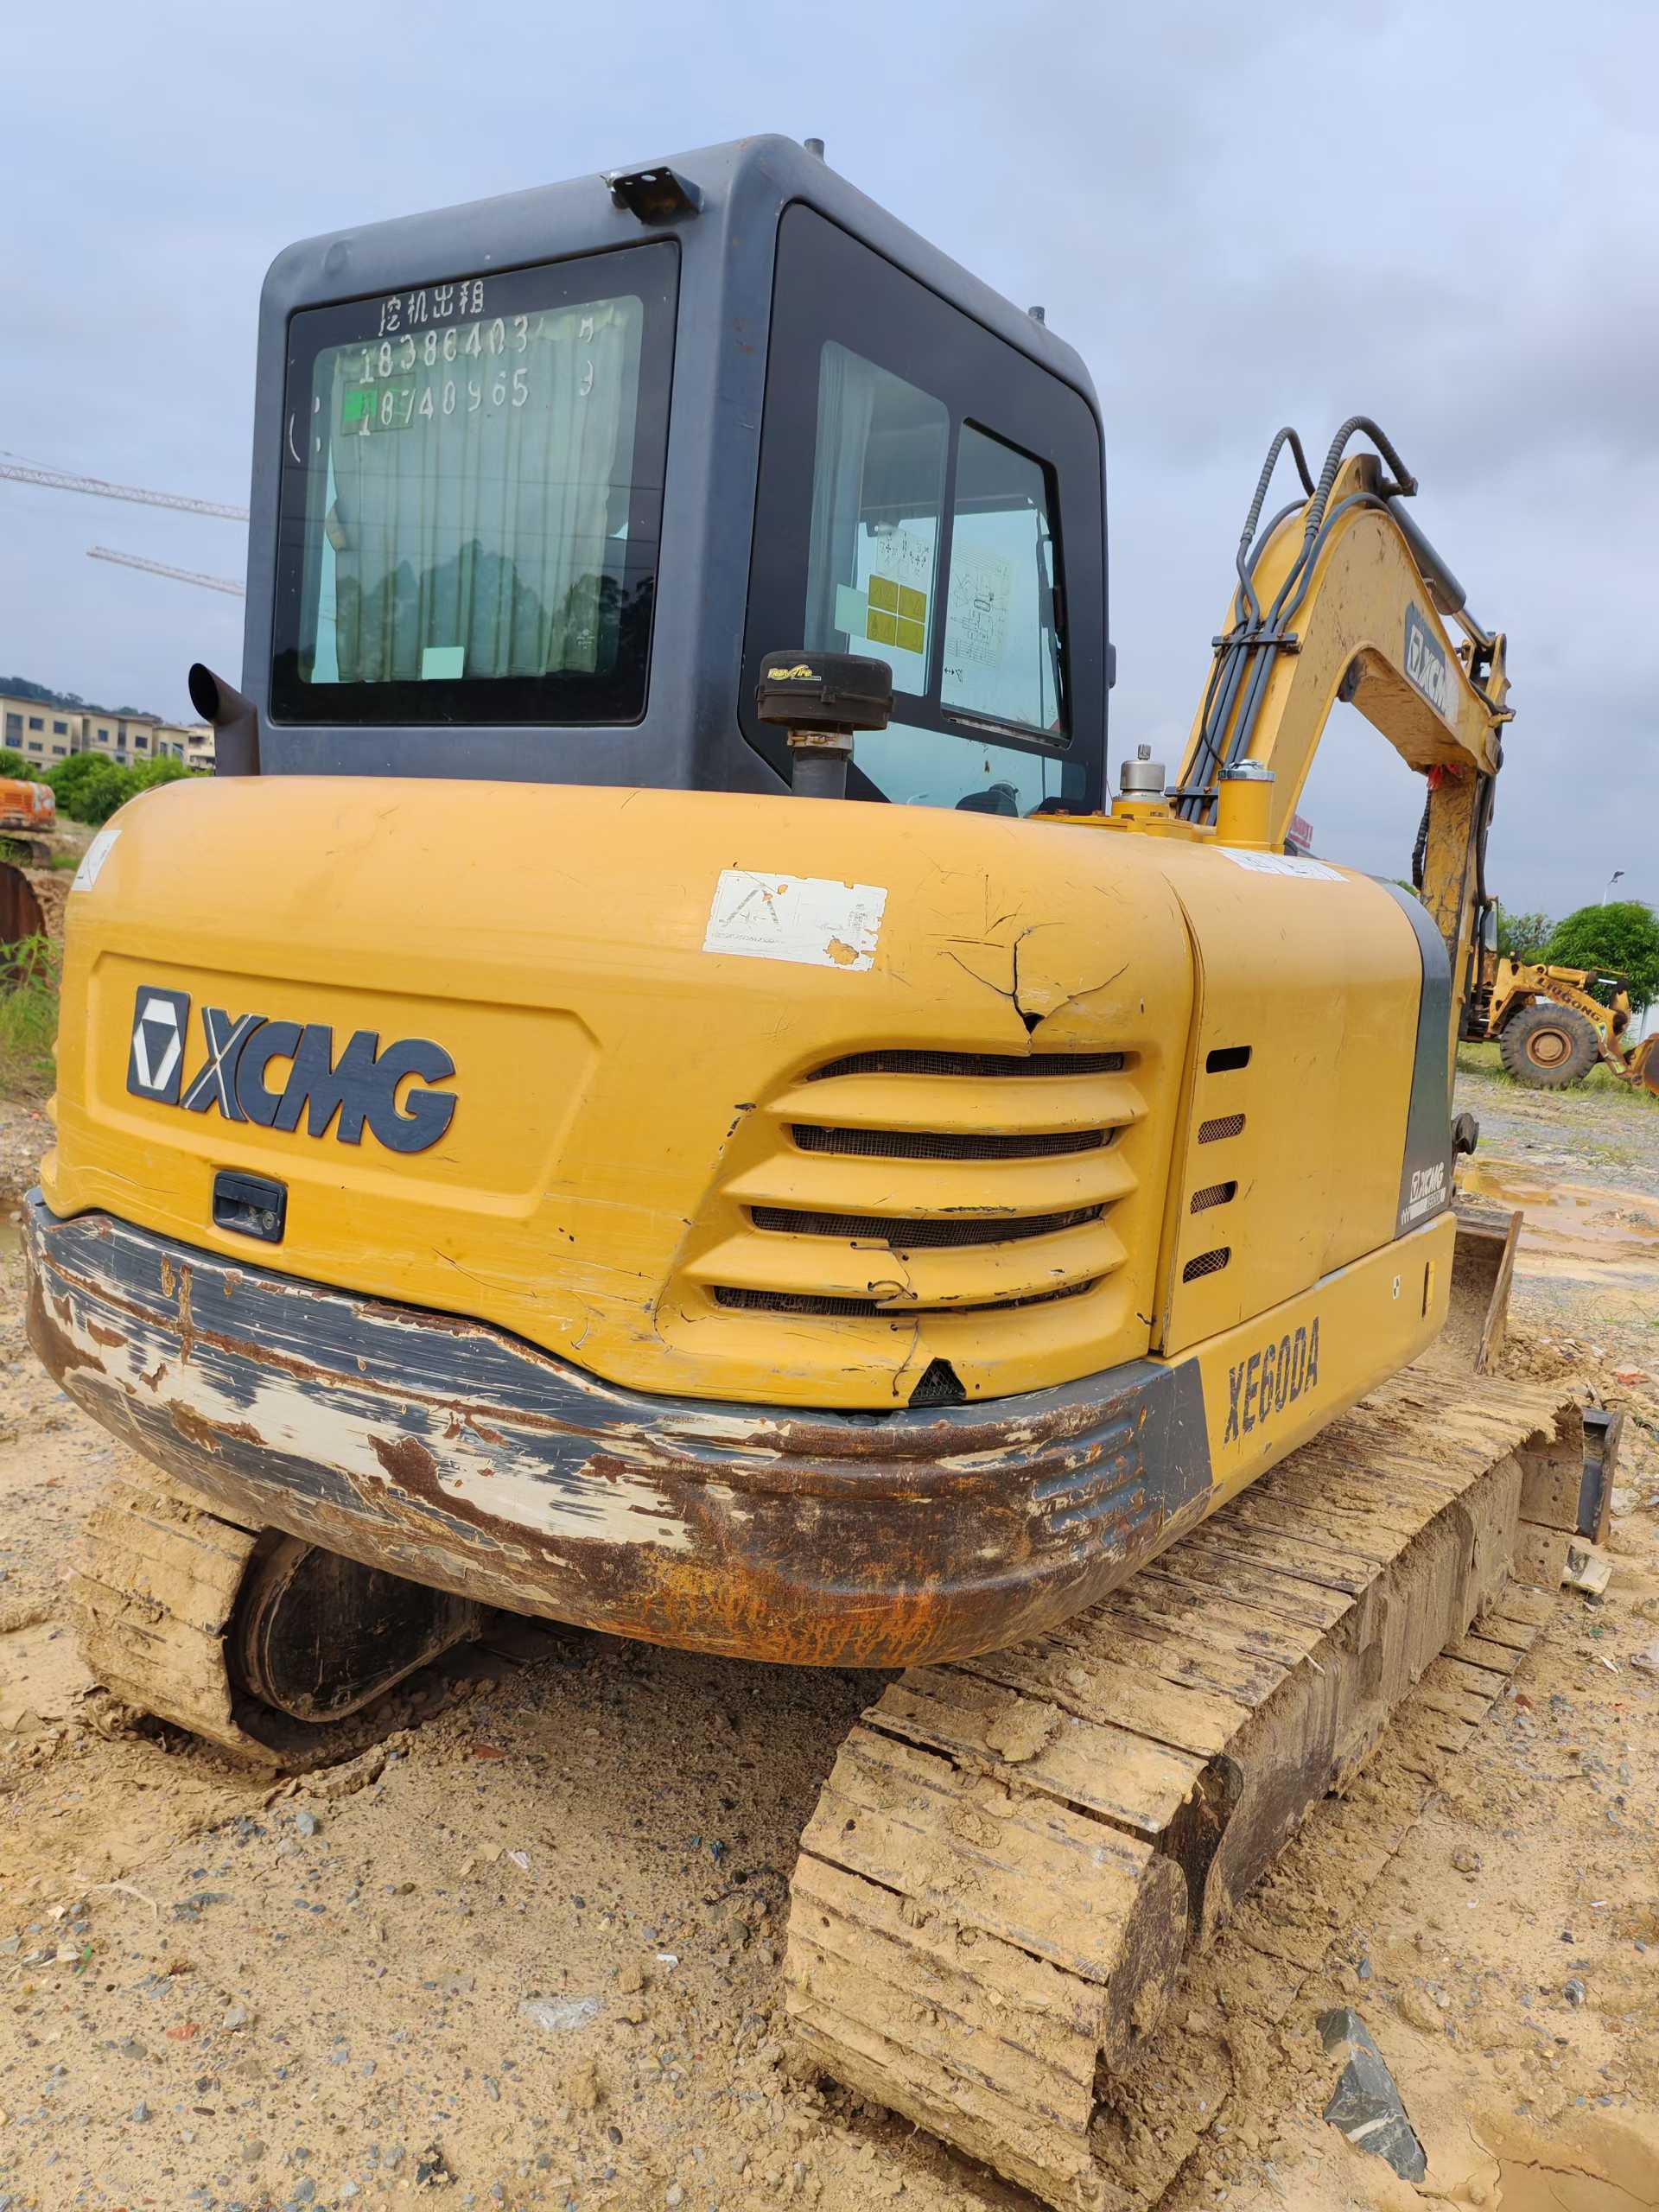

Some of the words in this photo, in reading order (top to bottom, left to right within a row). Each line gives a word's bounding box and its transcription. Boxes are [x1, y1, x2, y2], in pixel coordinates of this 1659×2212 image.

[378, 281, 484, 336] 挖机出租
[179, 1005, 458, 1154] XCMG
[1224, 1316, 1320, 1447] XE60DA
